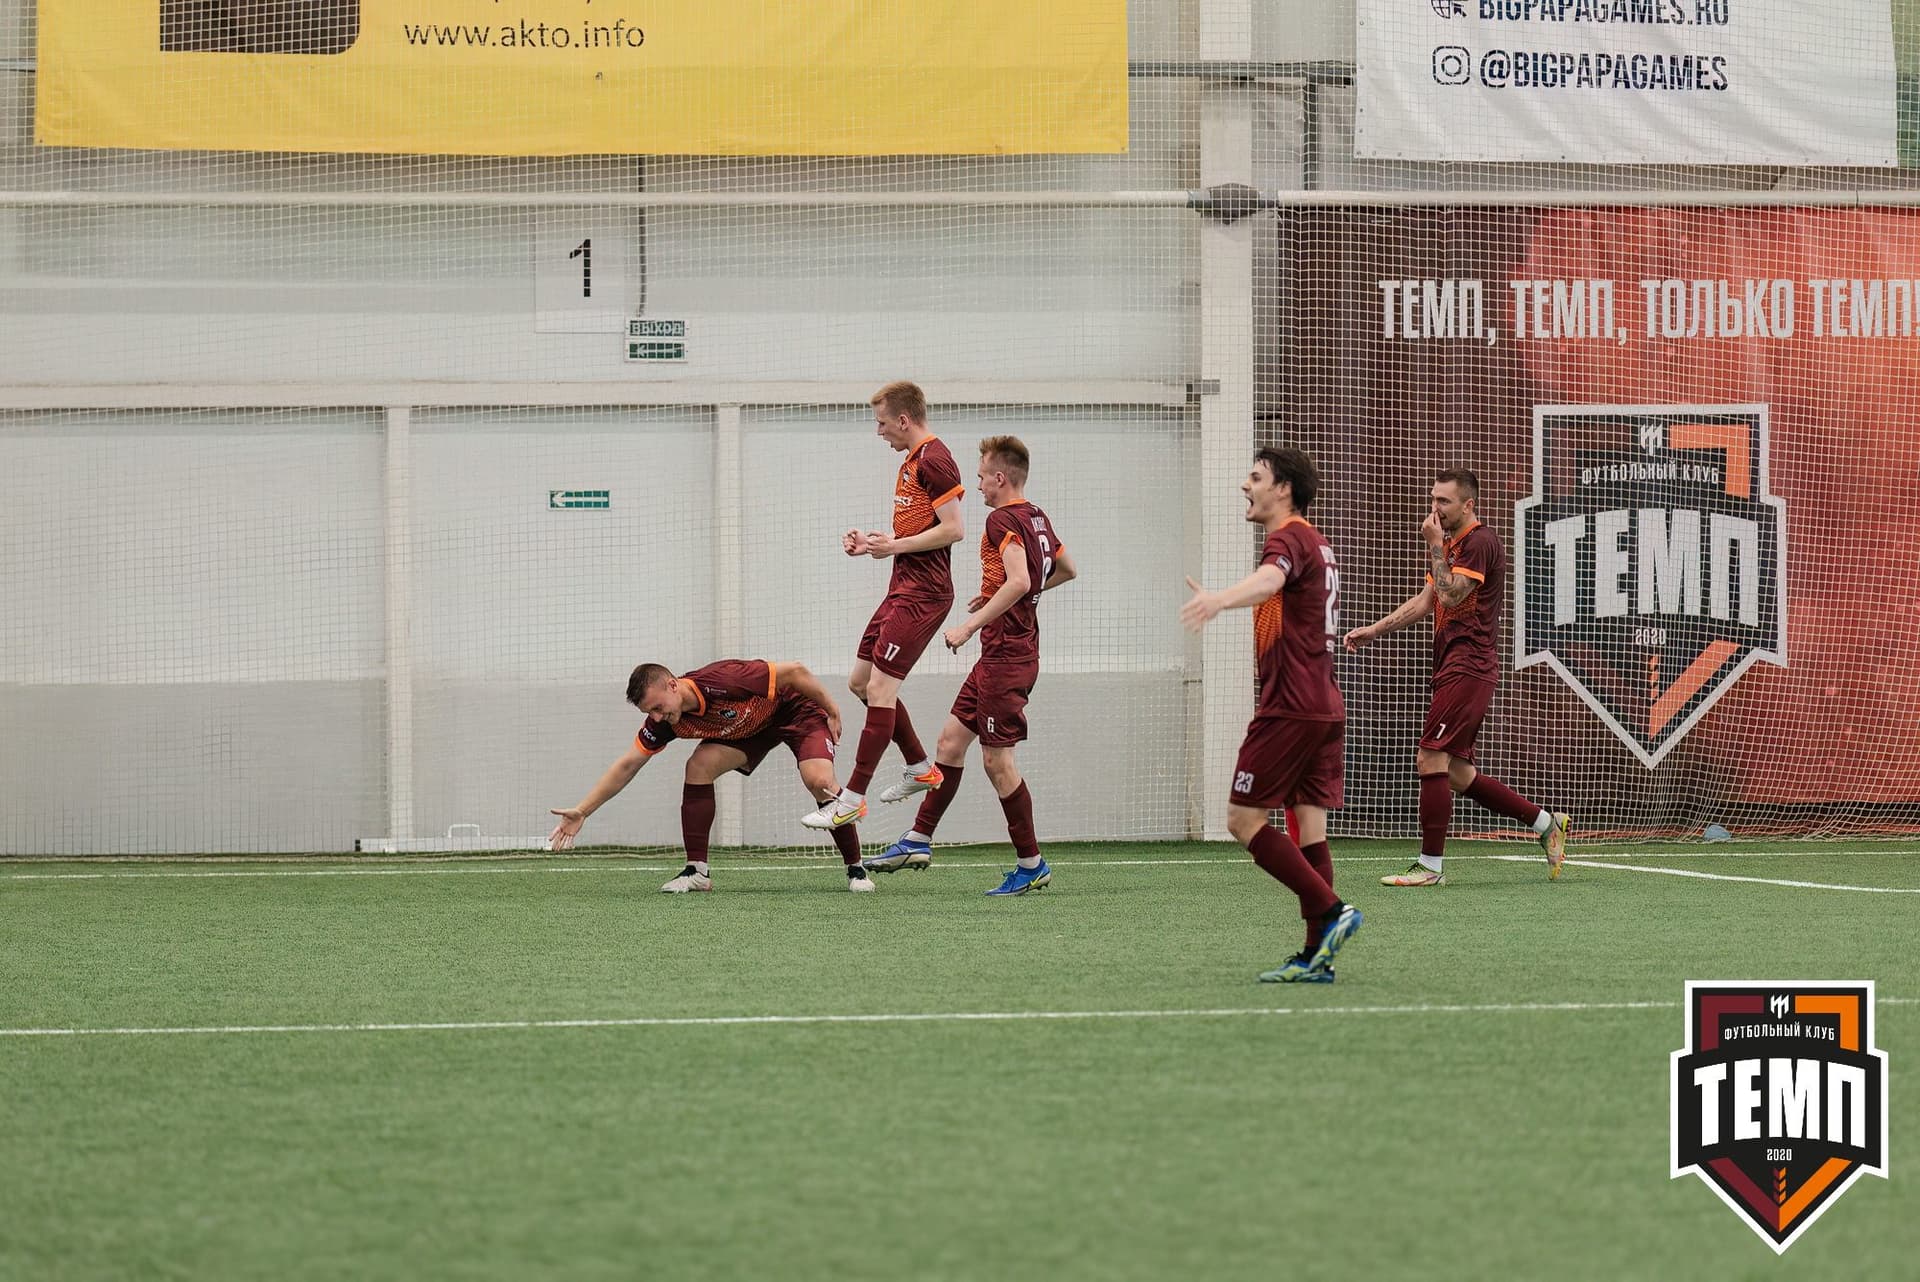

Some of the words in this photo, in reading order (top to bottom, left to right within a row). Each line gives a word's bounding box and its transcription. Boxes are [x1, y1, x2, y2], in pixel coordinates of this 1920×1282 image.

[404, 18, 645, 48] www.akto.info
[1480, 50, 1729, 91] @BIGPAPAGAMES
[569, 238, 591, 297] 1
[1379, 279, 1496, 346] ТЕМП,
[1510, 279, 1627, 345] ТЕМП,
[1641, 279, 1795, 338] ТОЛЬКО
[632, 321, 684, 335] ВЫХОД
[1581, 457, 1677, 485] ФУТБОЛЬНЫЙ
[1683, 463, 1719, 484] КЛУБ
[1545, 507, 1759, 628] ТЕМП
[1635, 628, 1667, 645] 2020
[883, 642, 900, 662] 17
[987, 717, 995, 733] 6
[1436, 723, 1447, 739] 7
[1234, 771, 1254, 793] 23
